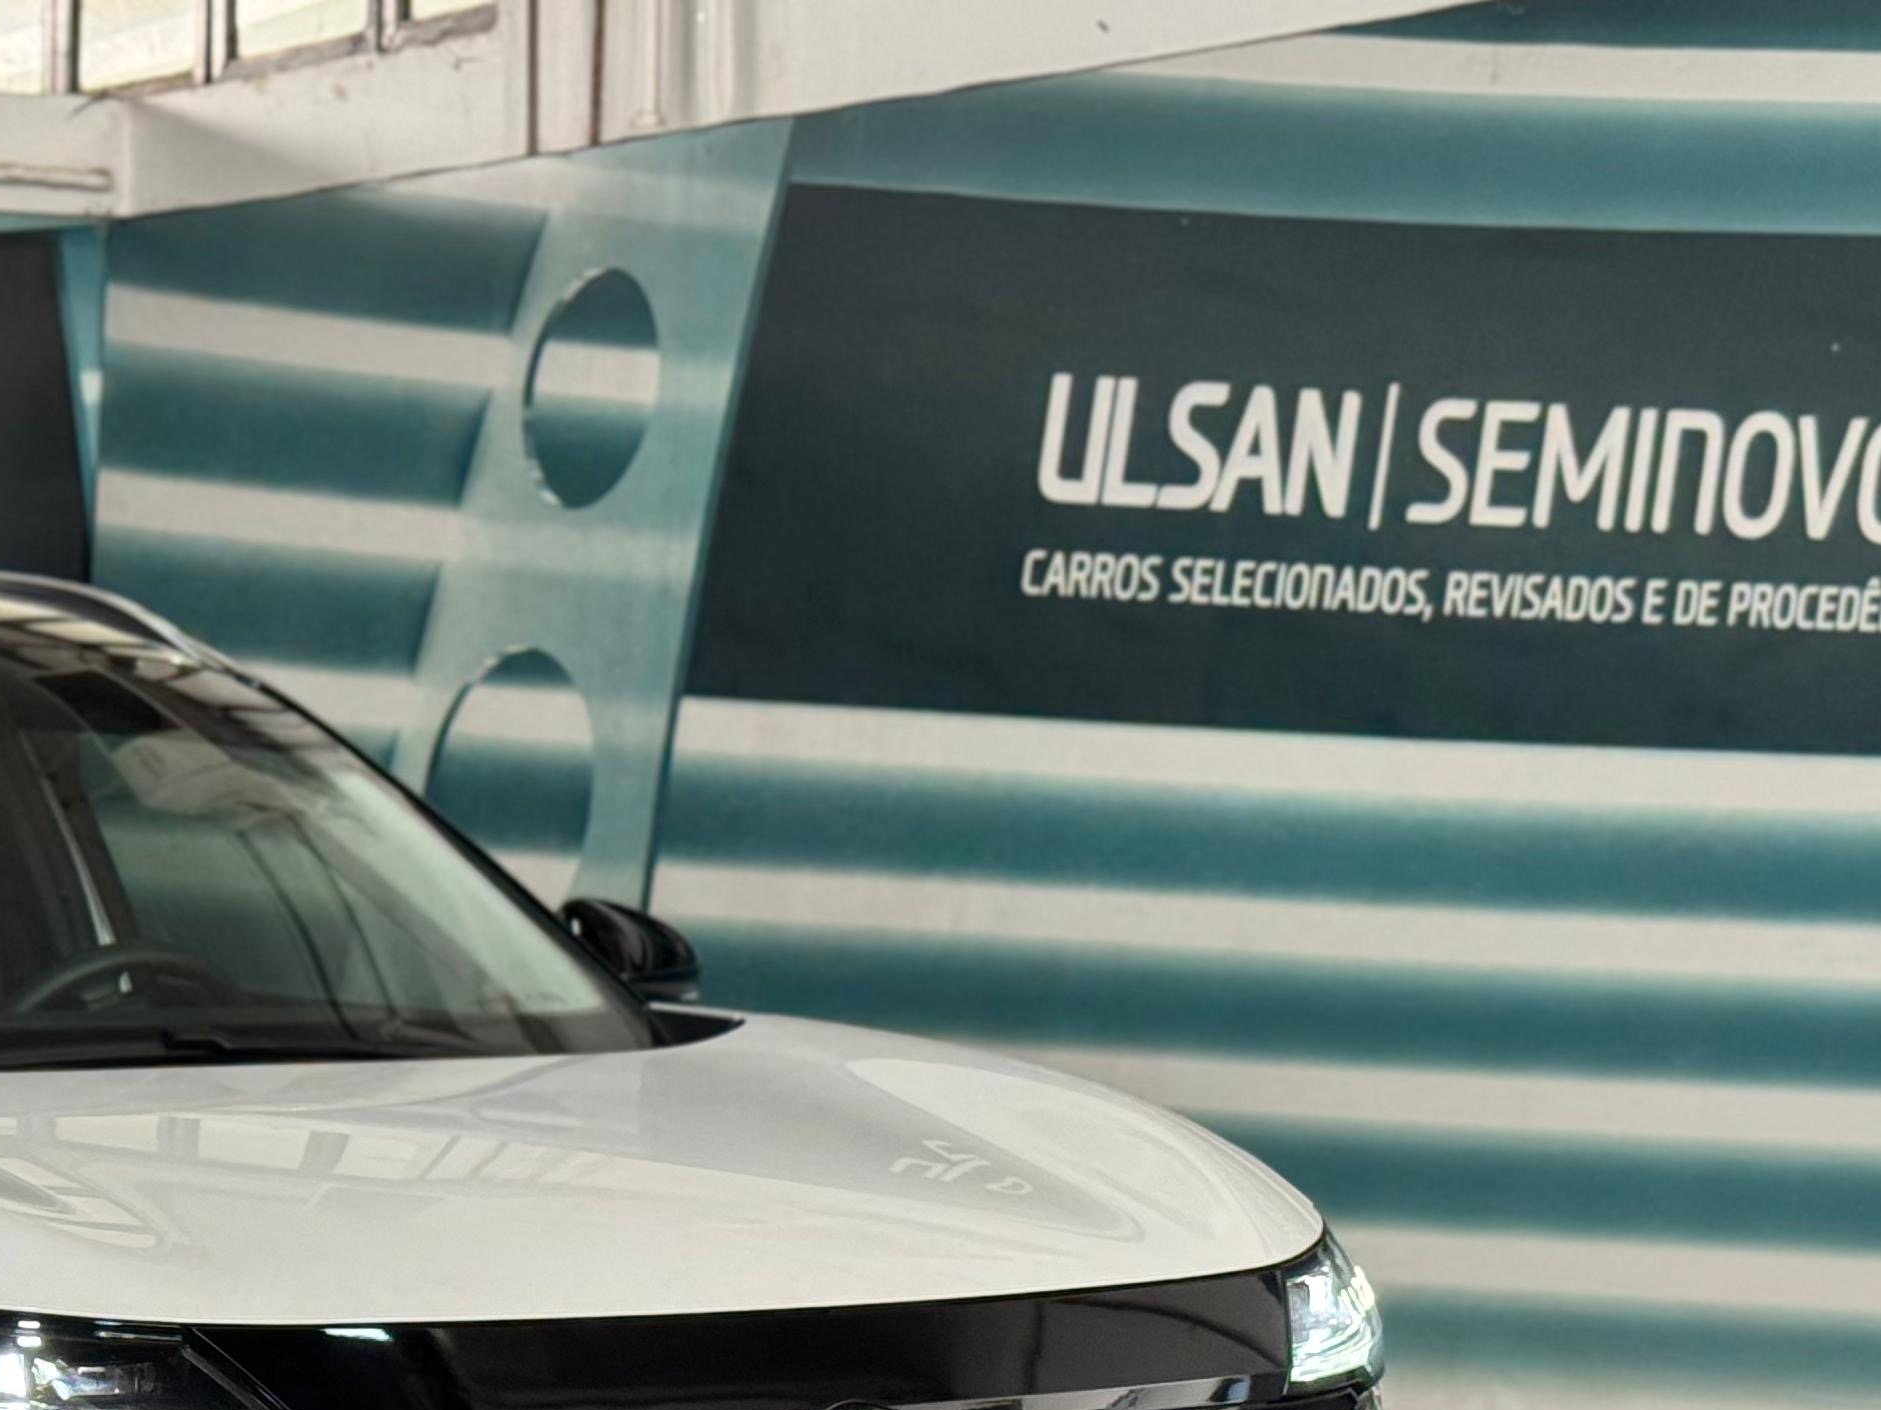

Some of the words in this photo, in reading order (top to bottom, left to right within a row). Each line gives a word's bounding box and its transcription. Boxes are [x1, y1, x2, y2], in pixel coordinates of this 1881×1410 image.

[1037, 371, 1364, 520] ULSAN
[1020, 548, 1163, 603] CARROS
[1167, 555, 1434, 623] SELECIONADOS,
[1441, 569, 1637, 625] REVISADOS
[1640, 577, 1669, 627] E
[1671, 578, 1724, 628] DE
